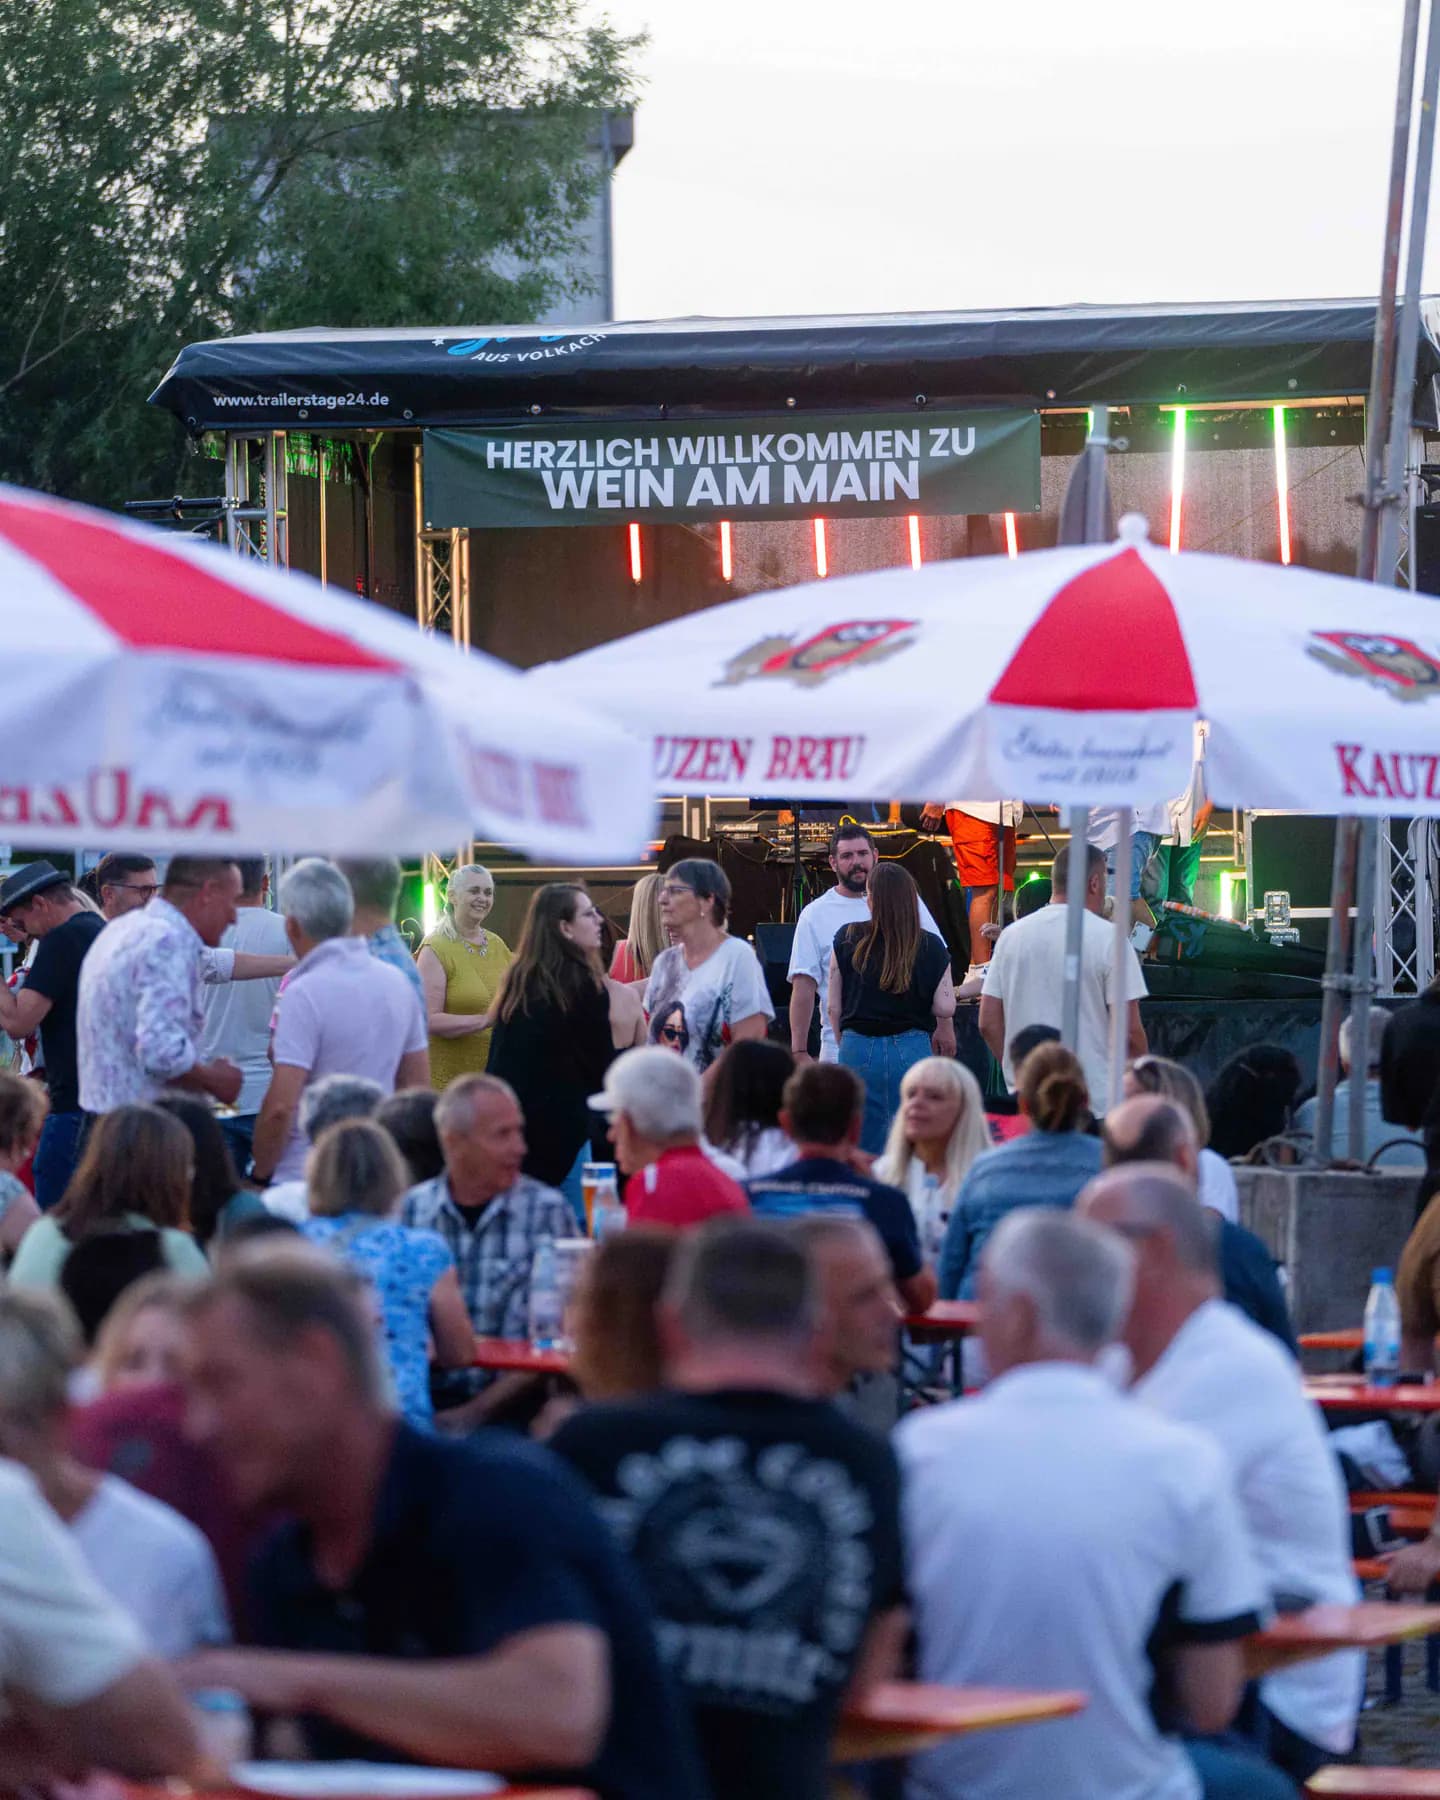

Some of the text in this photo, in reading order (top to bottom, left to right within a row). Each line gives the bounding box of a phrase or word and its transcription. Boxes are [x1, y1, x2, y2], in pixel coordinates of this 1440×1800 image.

[471, 351, 510, 363] AUS
[517, 333, 607, 362] VOLKACH
[213, 392, 390, 409] www.trailerstage24.de
[486, 426, 976, 469] HERZLICH WILLKOMMEN ZU
[541, 460, 920, 510] WEIN AM MAIN
